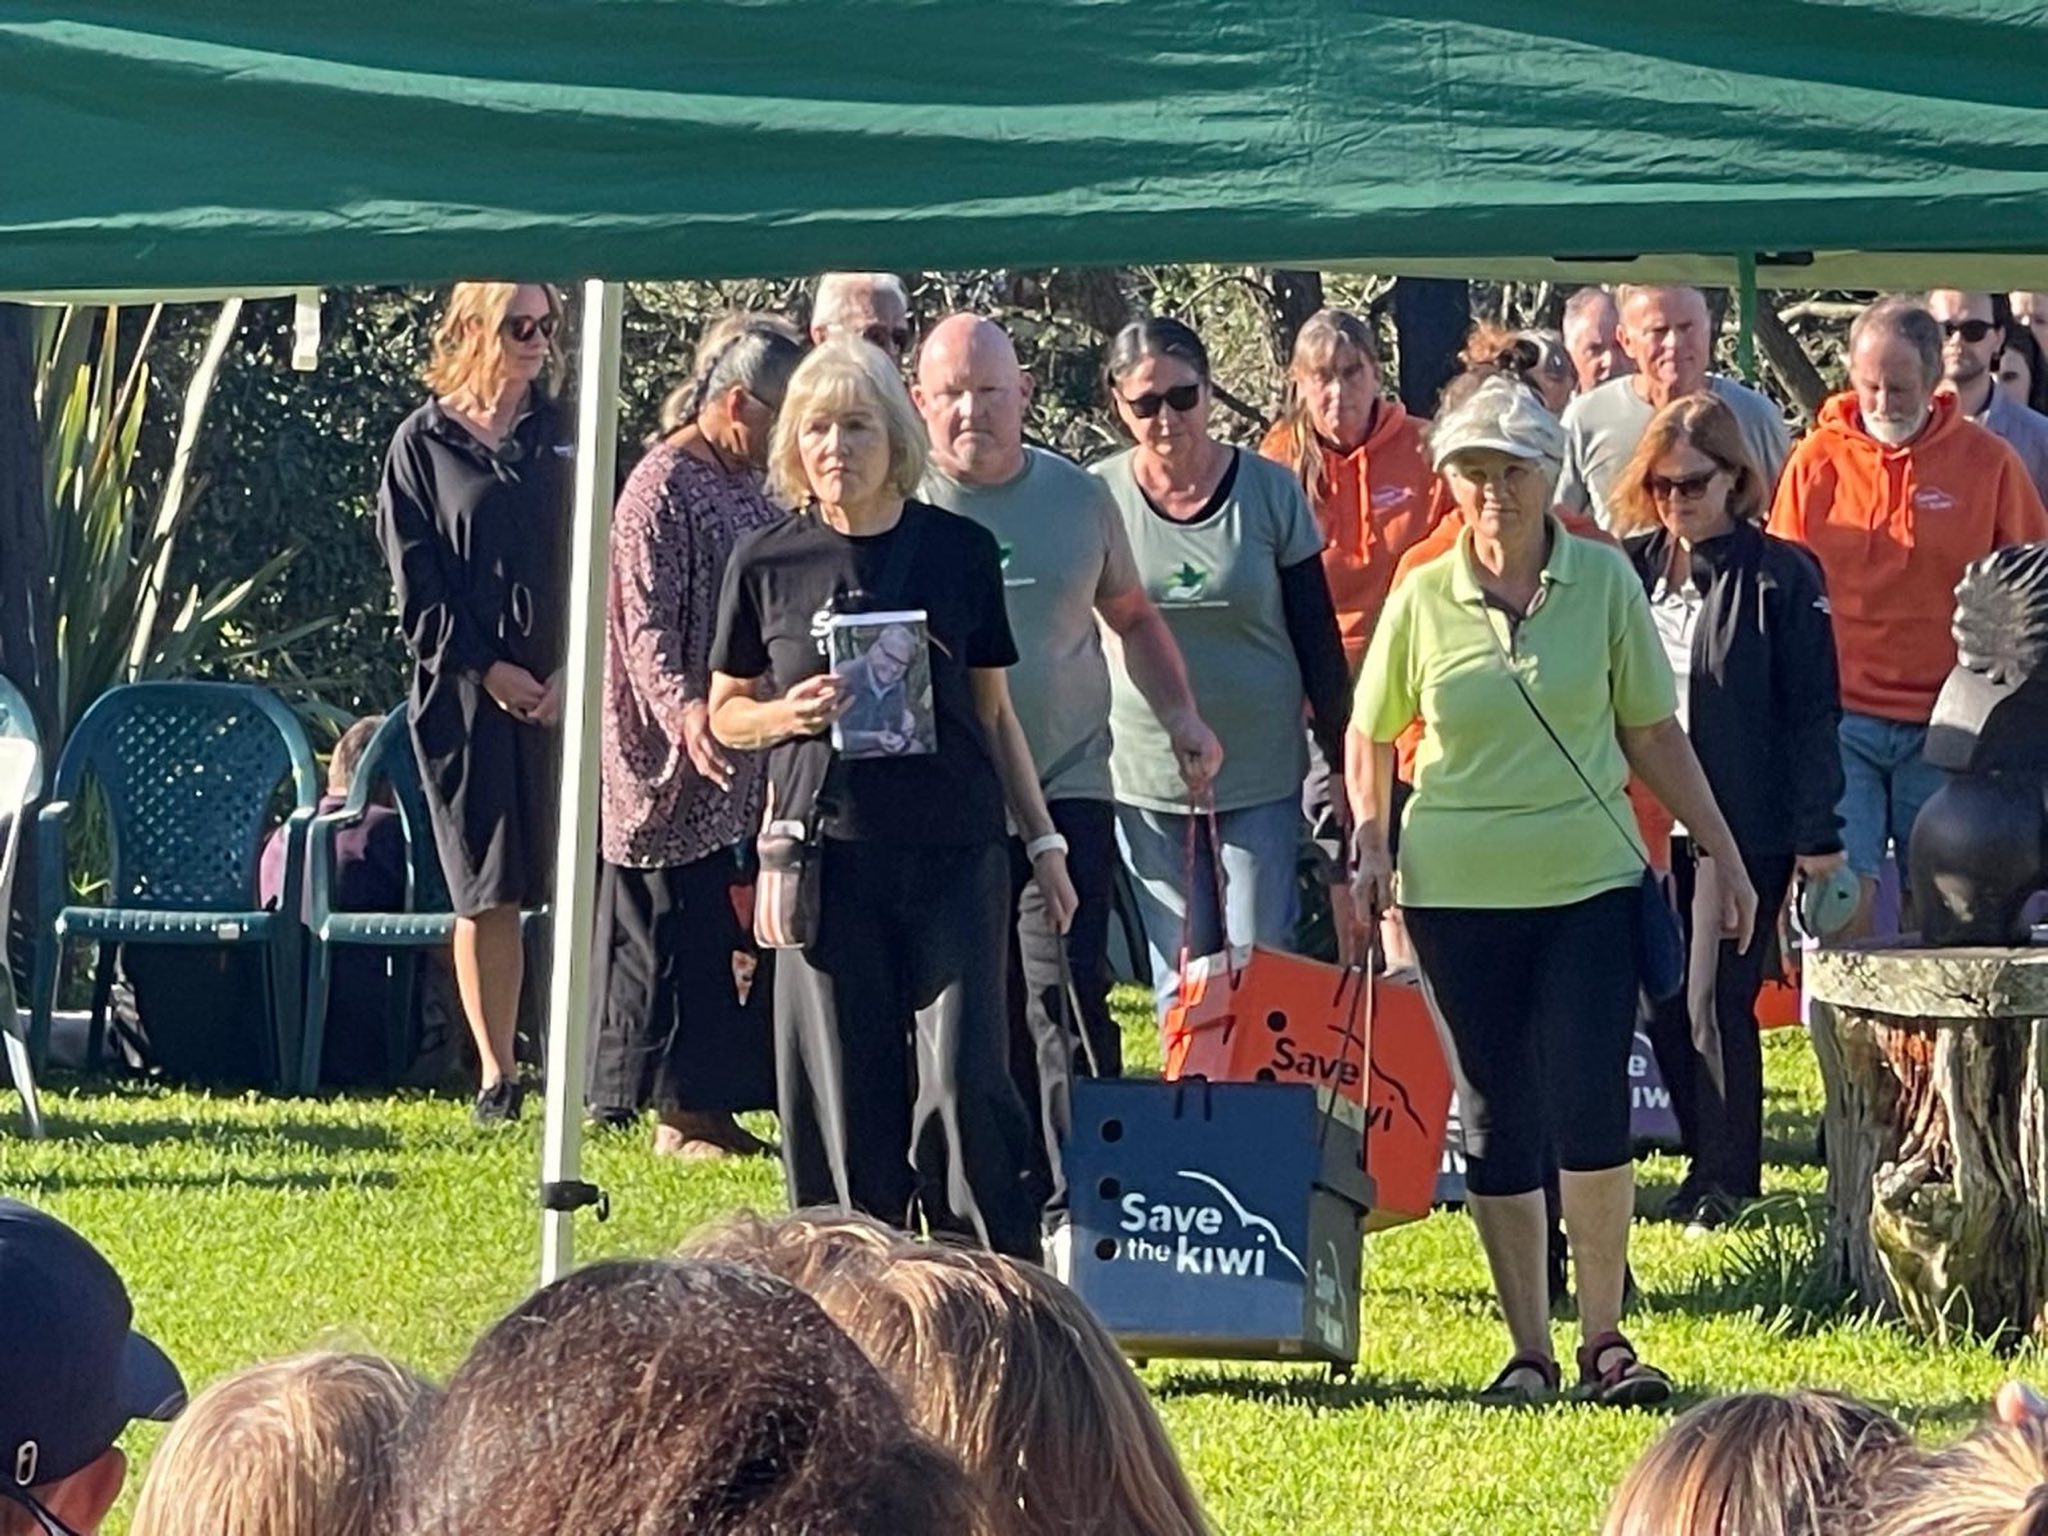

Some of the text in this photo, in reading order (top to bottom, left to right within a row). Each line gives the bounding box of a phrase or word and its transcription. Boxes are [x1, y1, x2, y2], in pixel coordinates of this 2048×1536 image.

[1271, 1037, 1360, 1086] Save
[1119, 1192, 1224, 1235] Save
[1127, 1233, 1266, 1277] the kiwi
